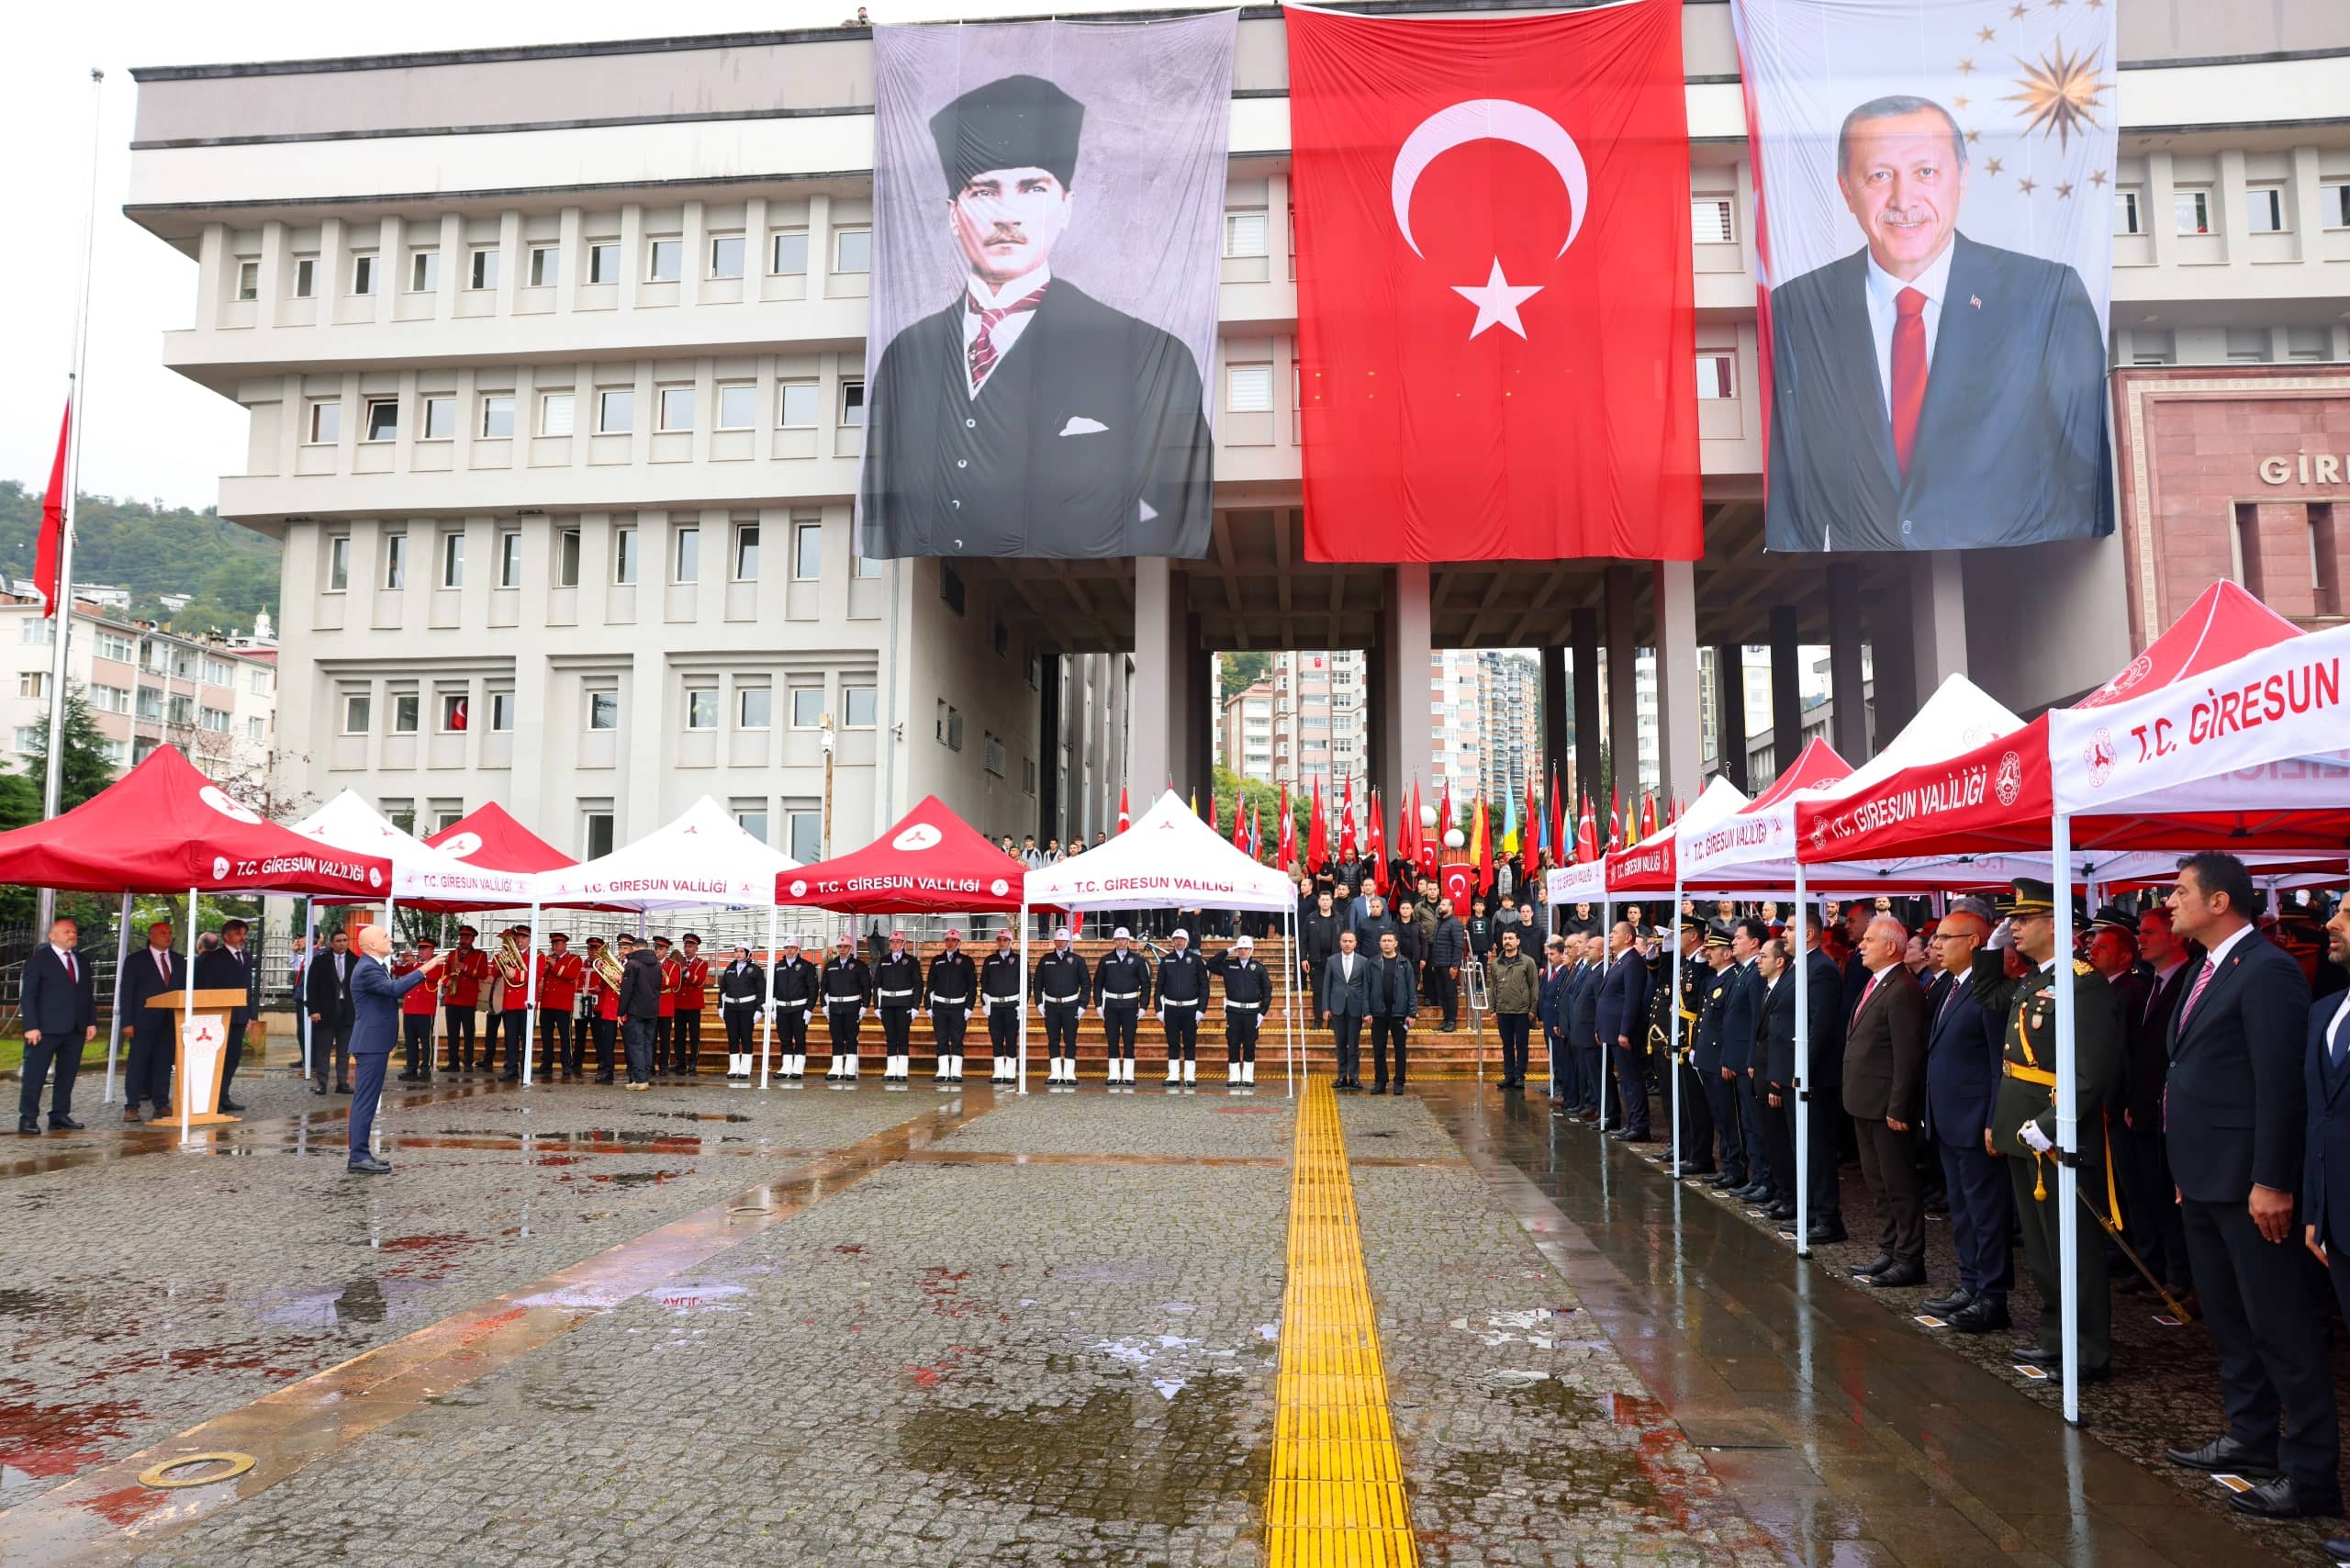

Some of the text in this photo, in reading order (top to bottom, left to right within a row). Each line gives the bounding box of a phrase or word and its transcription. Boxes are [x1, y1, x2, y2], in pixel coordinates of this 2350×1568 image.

[2259, 448, 2350, 486] GİR
[2130, 657, 2340, 764] T.C. GİRESUN
[1920, 764, 1987, 814] VALİLİĞİ
[1694, 817, 1767, 862] T.C. GİRESUN VALİLİĞİ
[237, 856, 364, 882] T.C. GİRESUN VALİLİĞİ
[424, 874, 512, 892] T.C. GİRESUN VALİLİĞİ
[673, 879, 727, 894] VALİLİĞİ
[817, 875, 979, 893] T.C. GİRESUN VALİLİĞİ
[1074, 880, 1100, 893] T.C.
[1104, 877, 1169, 890] GİRESUN
